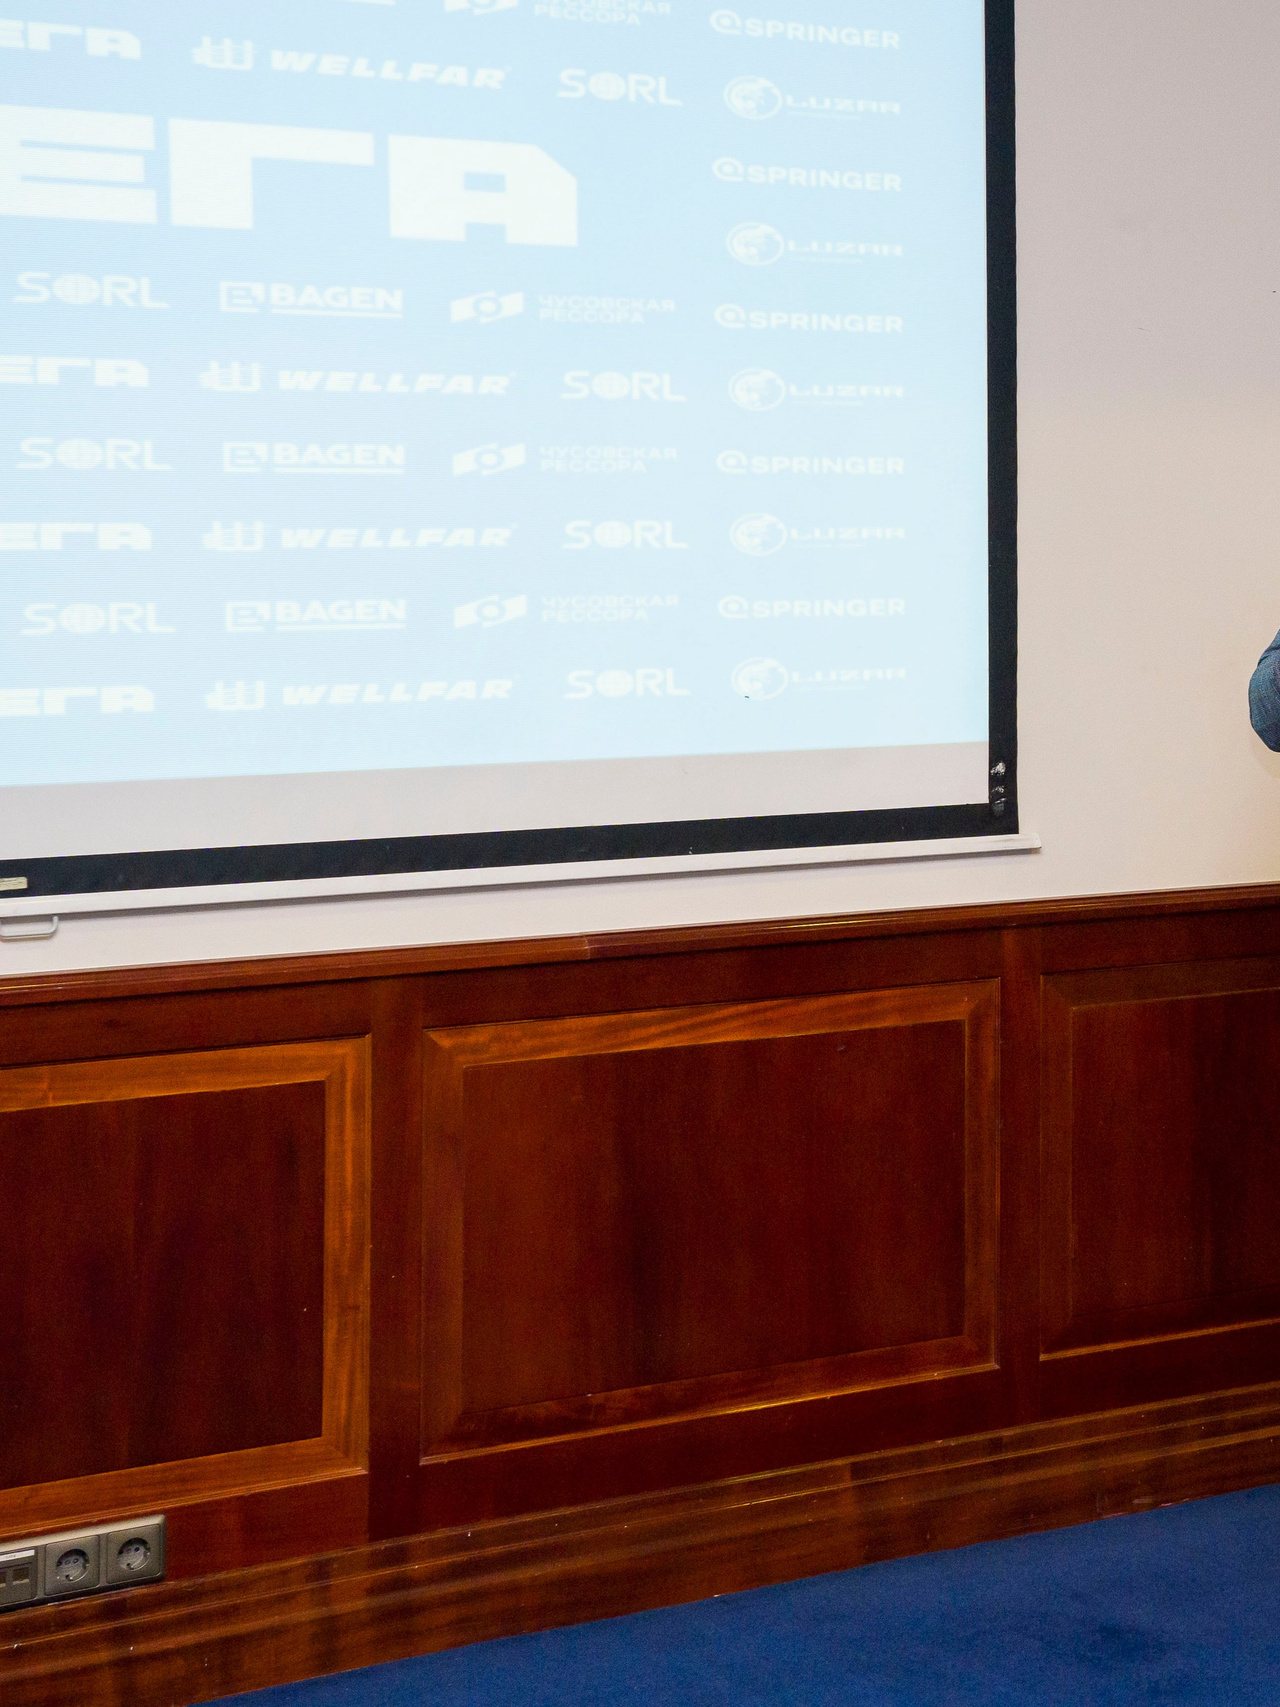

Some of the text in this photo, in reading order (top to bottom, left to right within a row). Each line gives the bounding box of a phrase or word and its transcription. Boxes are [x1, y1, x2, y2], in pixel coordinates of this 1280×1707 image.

[745, 18, 899, 48] SPRINGER
[271, 50, 503, 90] WELLFAR
[558, 69, 682, 105] SORL
[747, 165, 901, 191] SPRINGER
[15, 272, 170, 308] SORL
[270, 284, 403, 311] BAGEN
[749, 311, 903, 333] SPRINGER
[278, 371, 508, 395] WELLFAR
[562, 371, 686, 401] SORL
[19, 438, 172, 470] SORL
[274, 443, 405, 466] BAGEN
[751, 456, 904, 474] SPRINGER
[281, 527, 512, 549] WELLFAR
[564, 520, 687, 548] SORL
[23, 603, 175, 634] SORL
[276, 599, 406, 623] BAGEN
[753, 599, 905, 617] SPRINGER
[282, 679, 514, 706] WELLFAR
[565, 668, 690, 699] SORL
